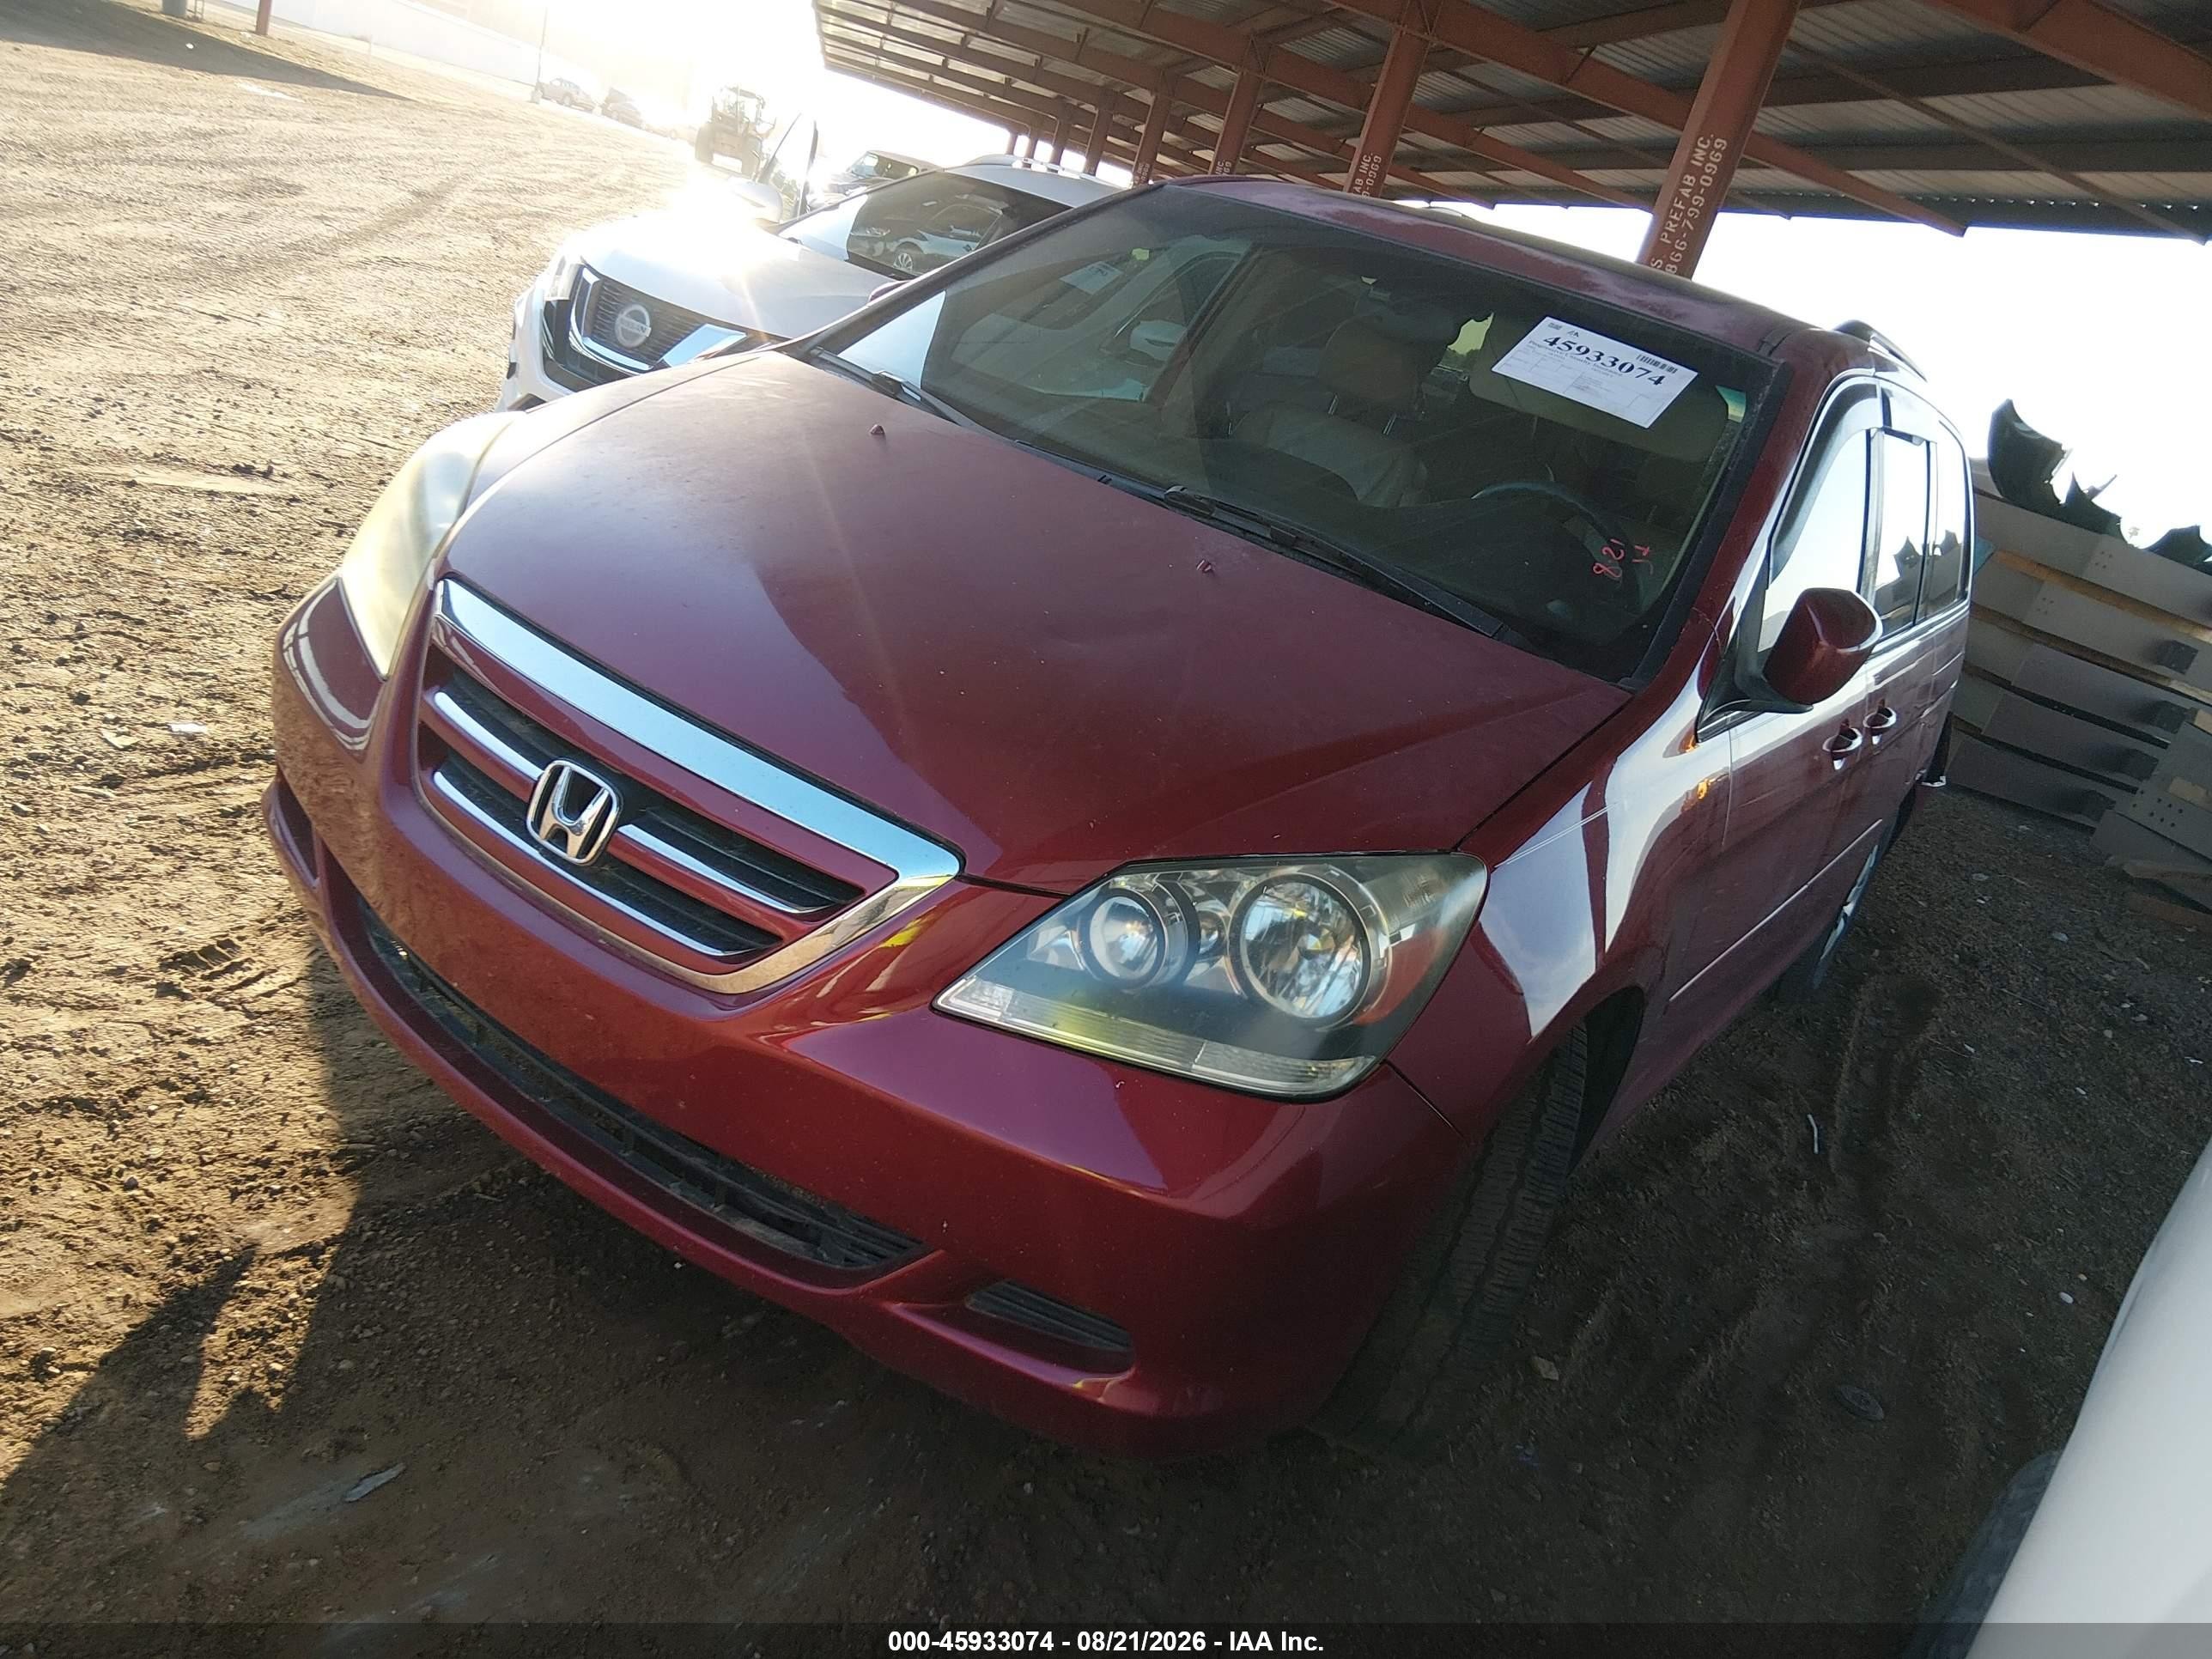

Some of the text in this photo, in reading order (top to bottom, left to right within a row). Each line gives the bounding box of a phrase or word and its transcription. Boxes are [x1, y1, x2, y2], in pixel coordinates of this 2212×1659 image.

[1358, 153, 1373, 174] INC.
[1660, 173, 1696, 244] PREFAB
[1690, 133, 1714, 167] INC.
[1665, 138, 1728, 274] 866-799-0969
[1543, 337, 1666, 386] 45933074
